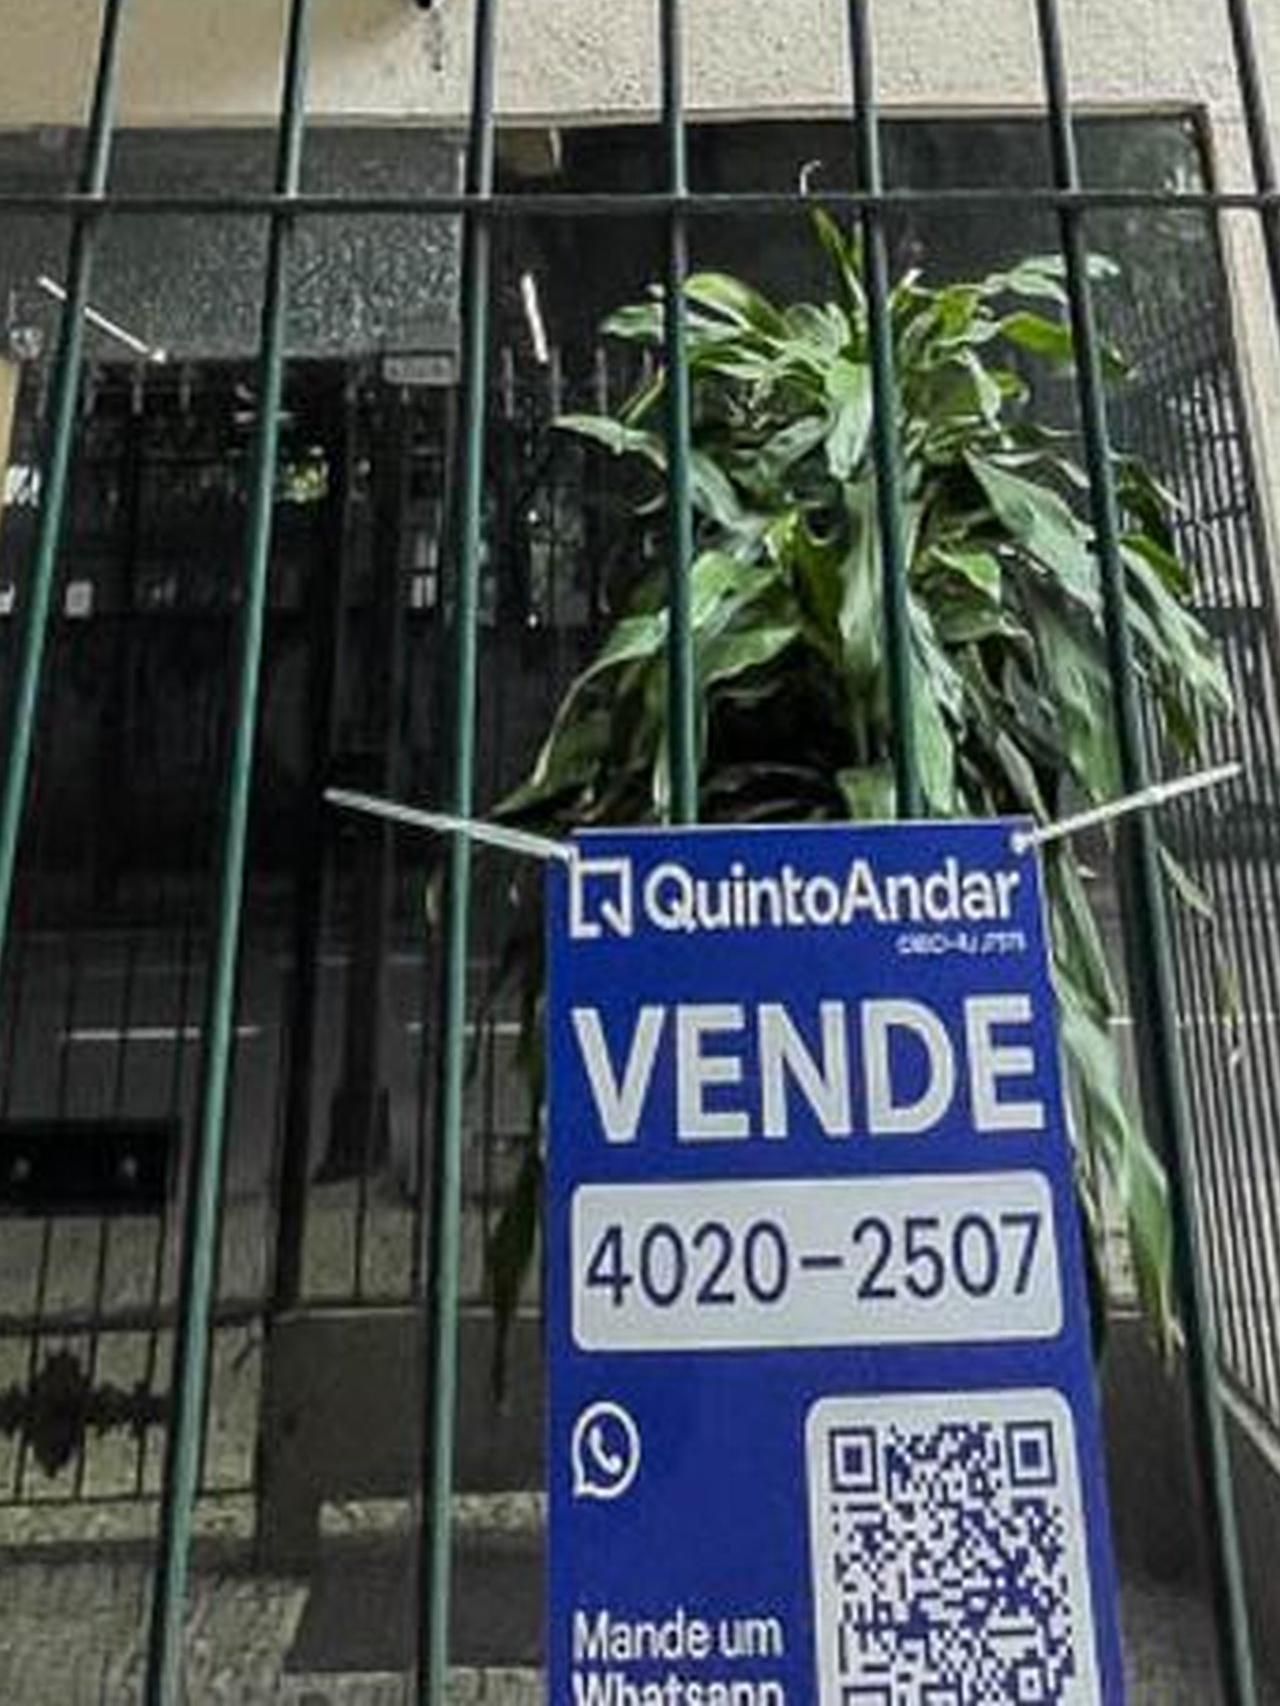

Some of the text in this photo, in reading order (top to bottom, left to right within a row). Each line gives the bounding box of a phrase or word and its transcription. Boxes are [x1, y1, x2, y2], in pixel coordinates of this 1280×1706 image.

[643, 857, 1020, 933] QuintoAndar
[572, 994, 1046, 1143] VENDE
[585, 1212, 1044, 1307] 4020-2507
[574, 1606, 783, 1662] Mande um
